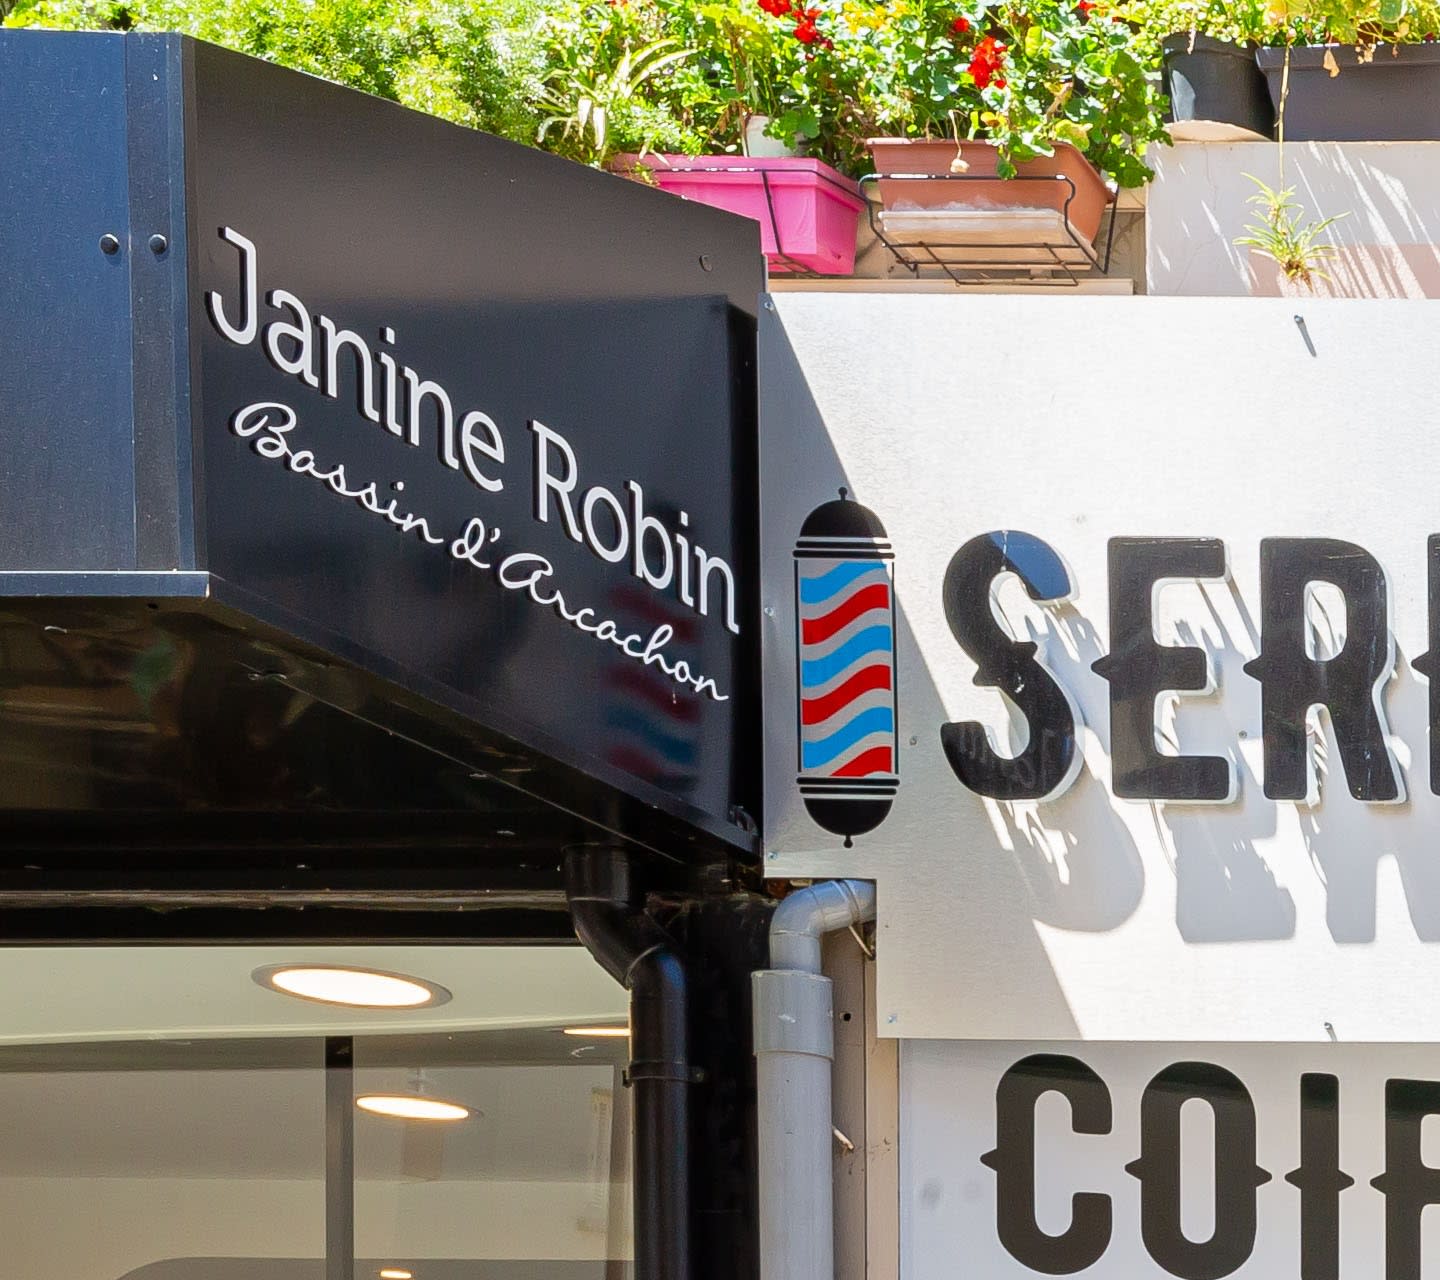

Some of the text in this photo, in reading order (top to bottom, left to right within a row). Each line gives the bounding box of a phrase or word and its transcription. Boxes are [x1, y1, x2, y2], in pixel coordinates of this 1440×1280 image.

[210, 226, 740, 635] Janine Robin
[234, 401, 729, 702] Bassin d'Arcachon
